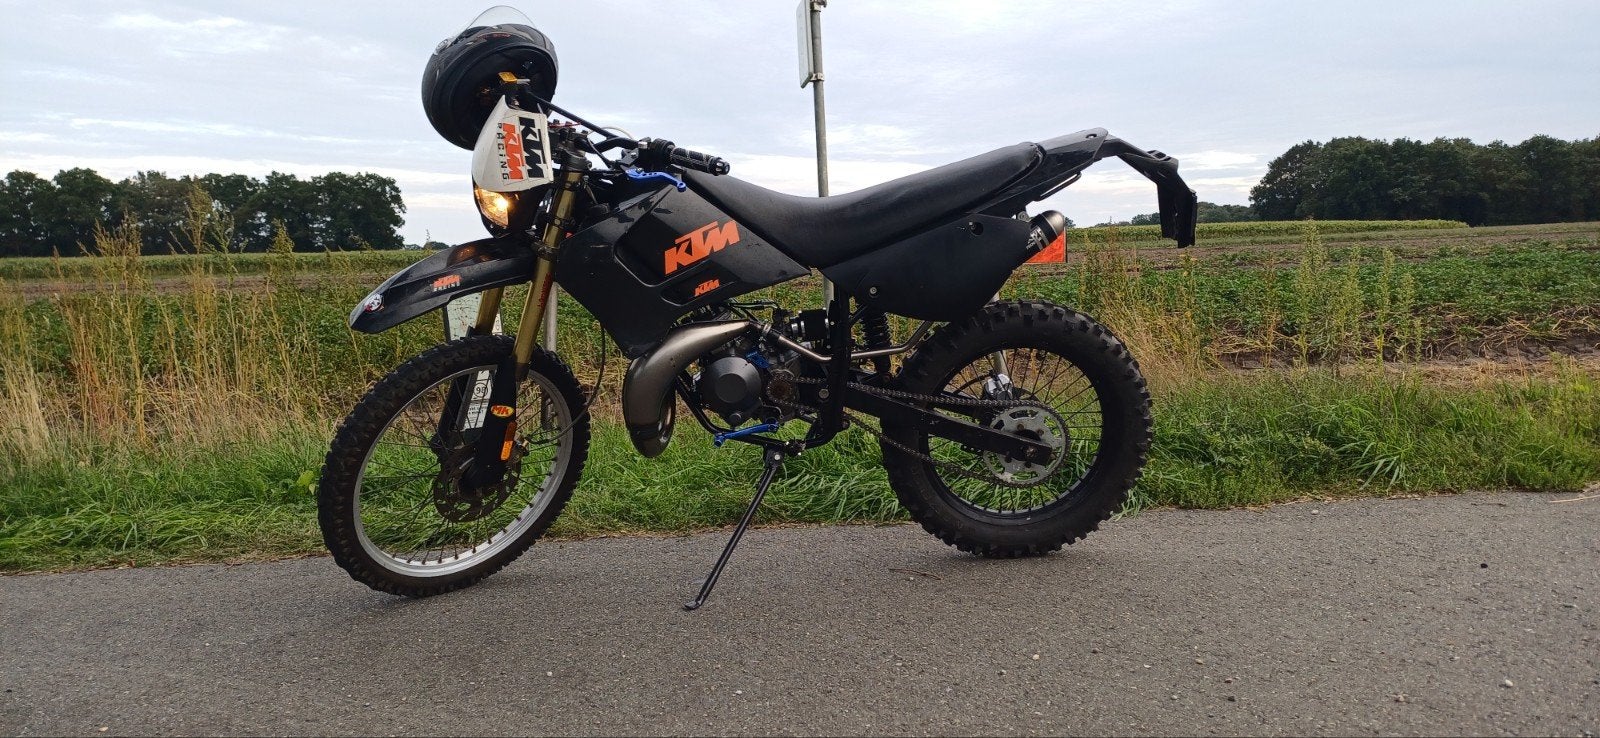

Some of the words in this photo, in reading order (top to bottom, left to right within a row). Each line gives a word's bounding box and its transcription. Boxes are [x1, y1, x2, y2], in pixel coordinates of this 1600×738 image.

[502, 122, 525, 180] KTM
[519, 116, 547, 178] KTM
[664, 220, 740, 275] KTM
[694, 279, 720, 297] KTM
